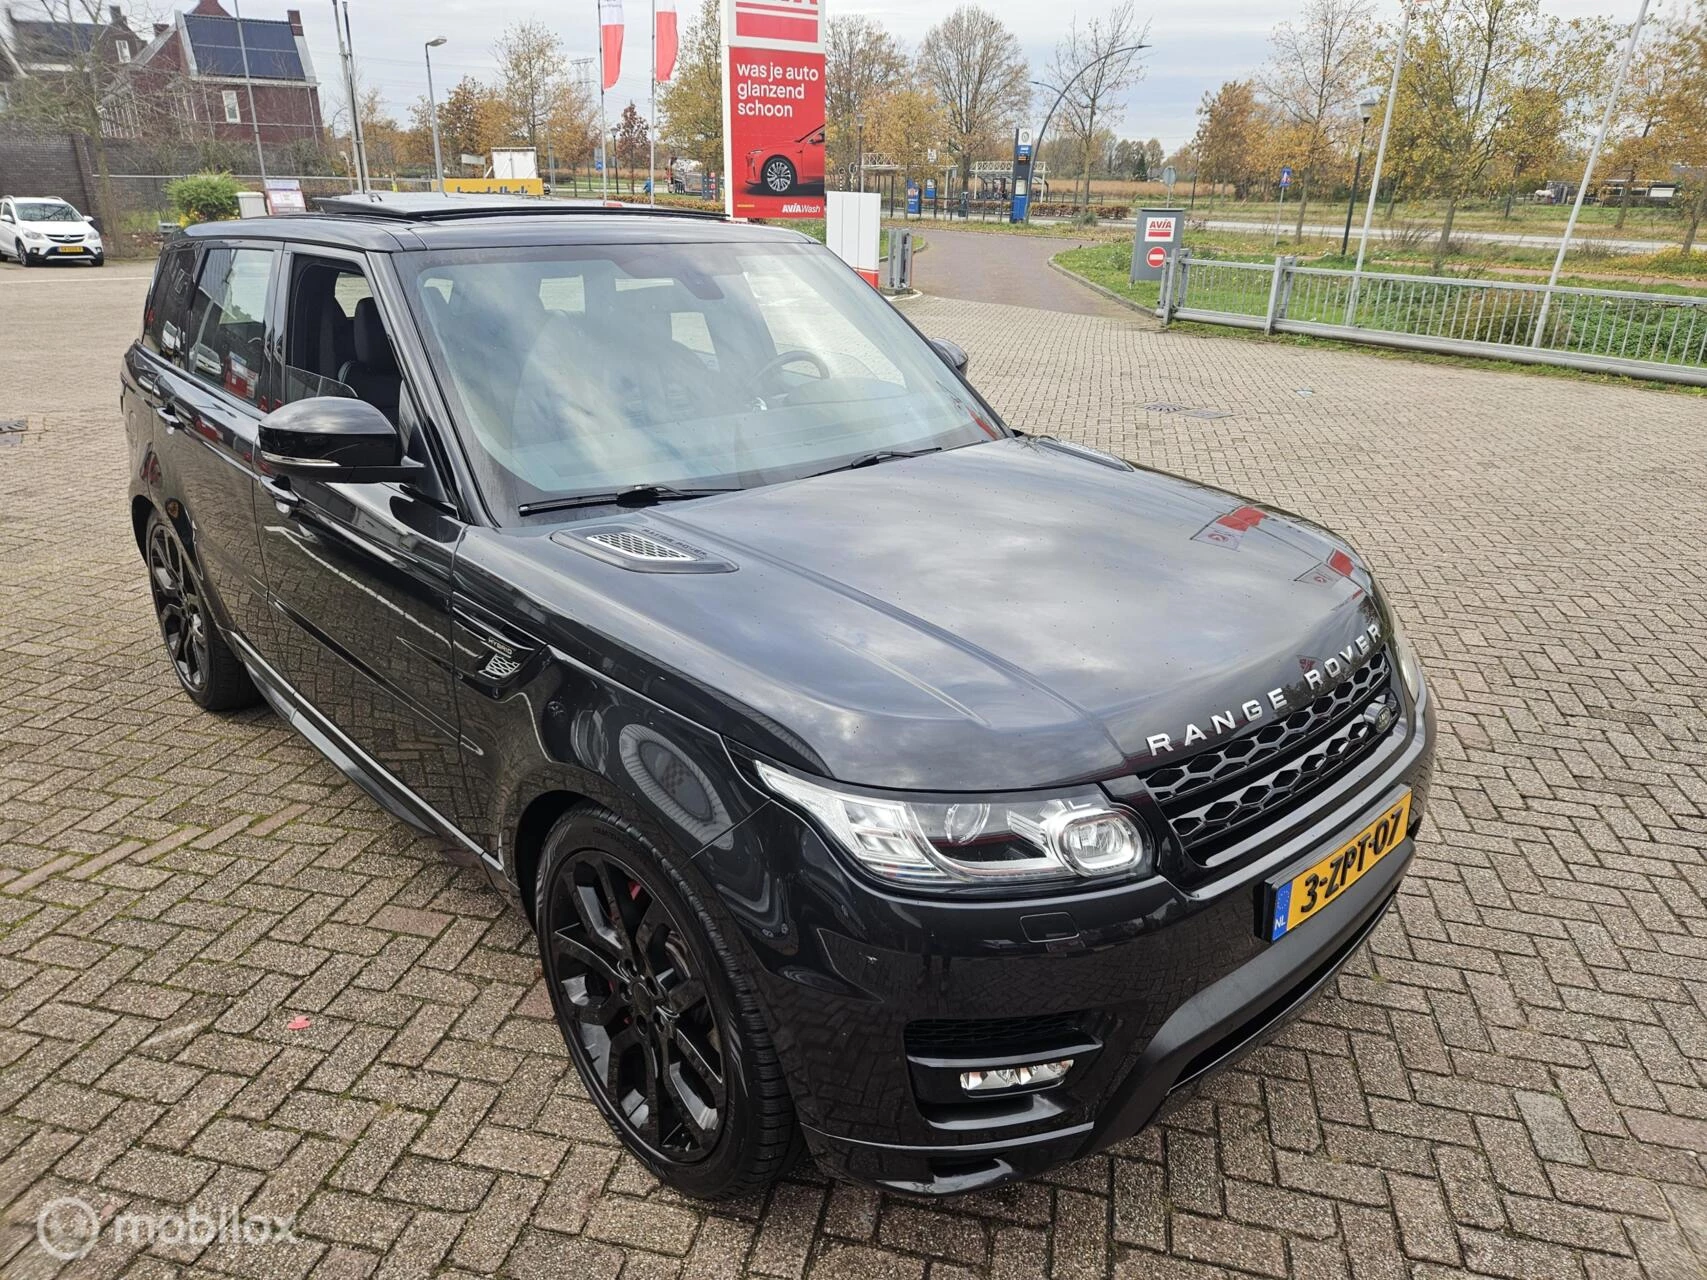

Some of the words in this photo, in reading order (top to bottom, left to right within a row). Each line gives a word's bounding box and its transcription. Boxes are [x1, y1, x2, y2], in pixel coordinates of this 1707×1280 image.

[736, 63, 767, 78] was
[768, 61, 783, 83] je
[785, 65, 819, 82] auto
[737, 79, 805, 100] glanzend
[737, 99, 793, 118] schoon
[487, 636, 513, 655] HYBRID
[1145, 687, 1288, 757] RANGE
[1303, 623, 1382, 690] ROVER
[1300, 806, 1404, 913] 3-ZPT-07
[1274, 915, 1286, 930] NL
